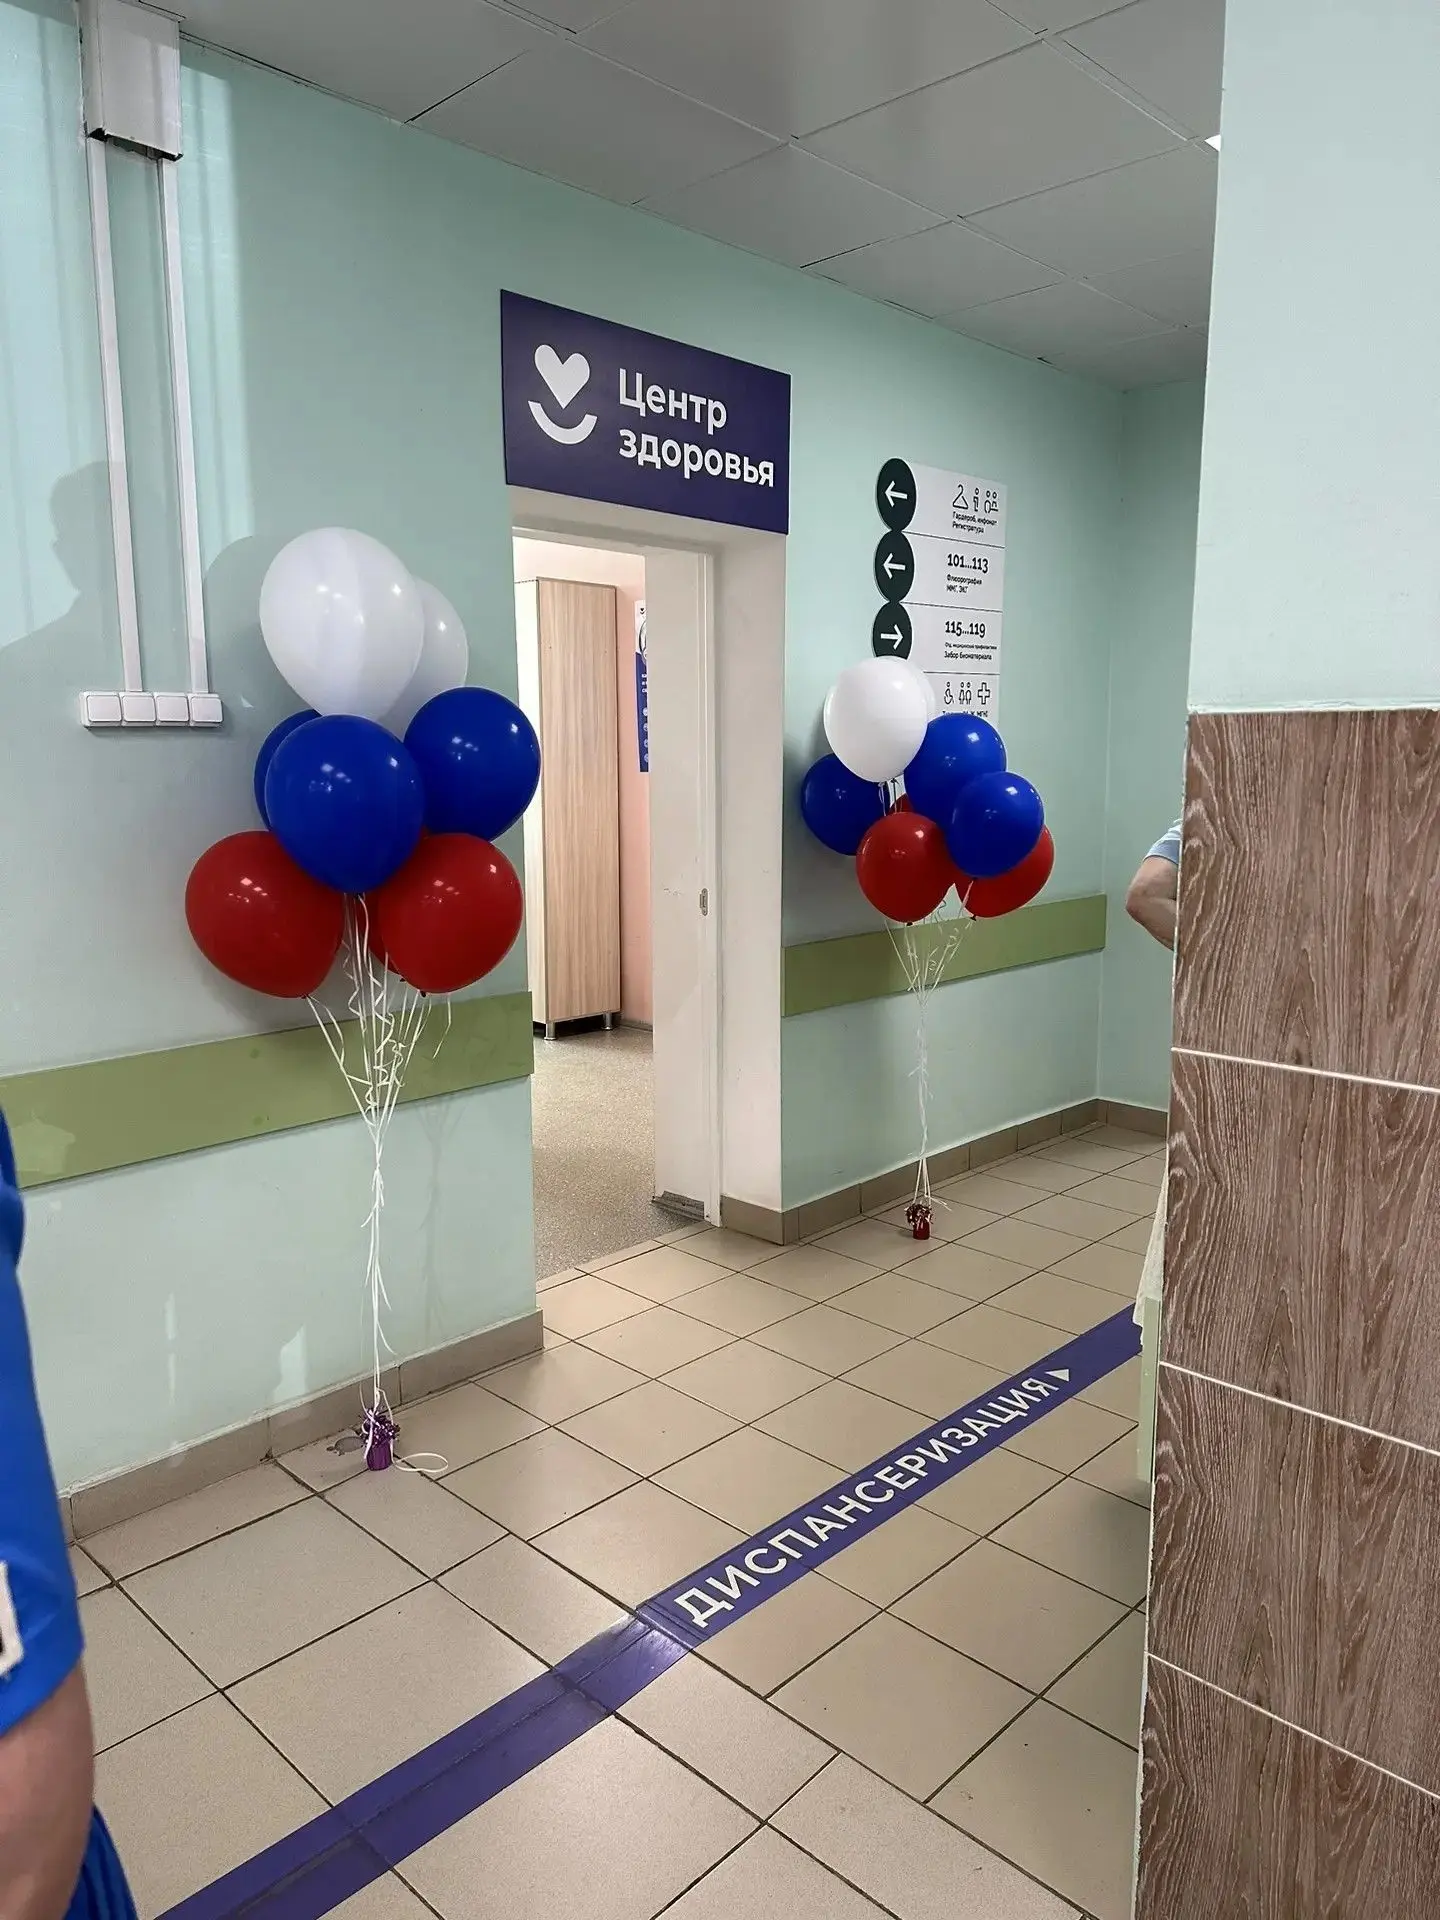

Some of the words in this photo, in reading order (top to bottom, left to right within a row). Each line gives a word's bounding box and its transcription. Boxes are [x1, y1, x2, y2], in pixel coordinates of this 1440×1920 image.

[619, 367, 728, 436] Центр
[618, 428, 774, 488] здоровья
[952, 520, 984, 534] Регистратура
[947, 553, 989, 574] 101...113
[946, 573, 982, 585] Флюорография
[945, 620, 986, 639] 115...119
[944, 650, 959, 659] Забор
[959, 651, 992, 661] биоматериала
[673, 1376, 1060, 1629] ДИСПАНСЕРИЗАЦИЯ
